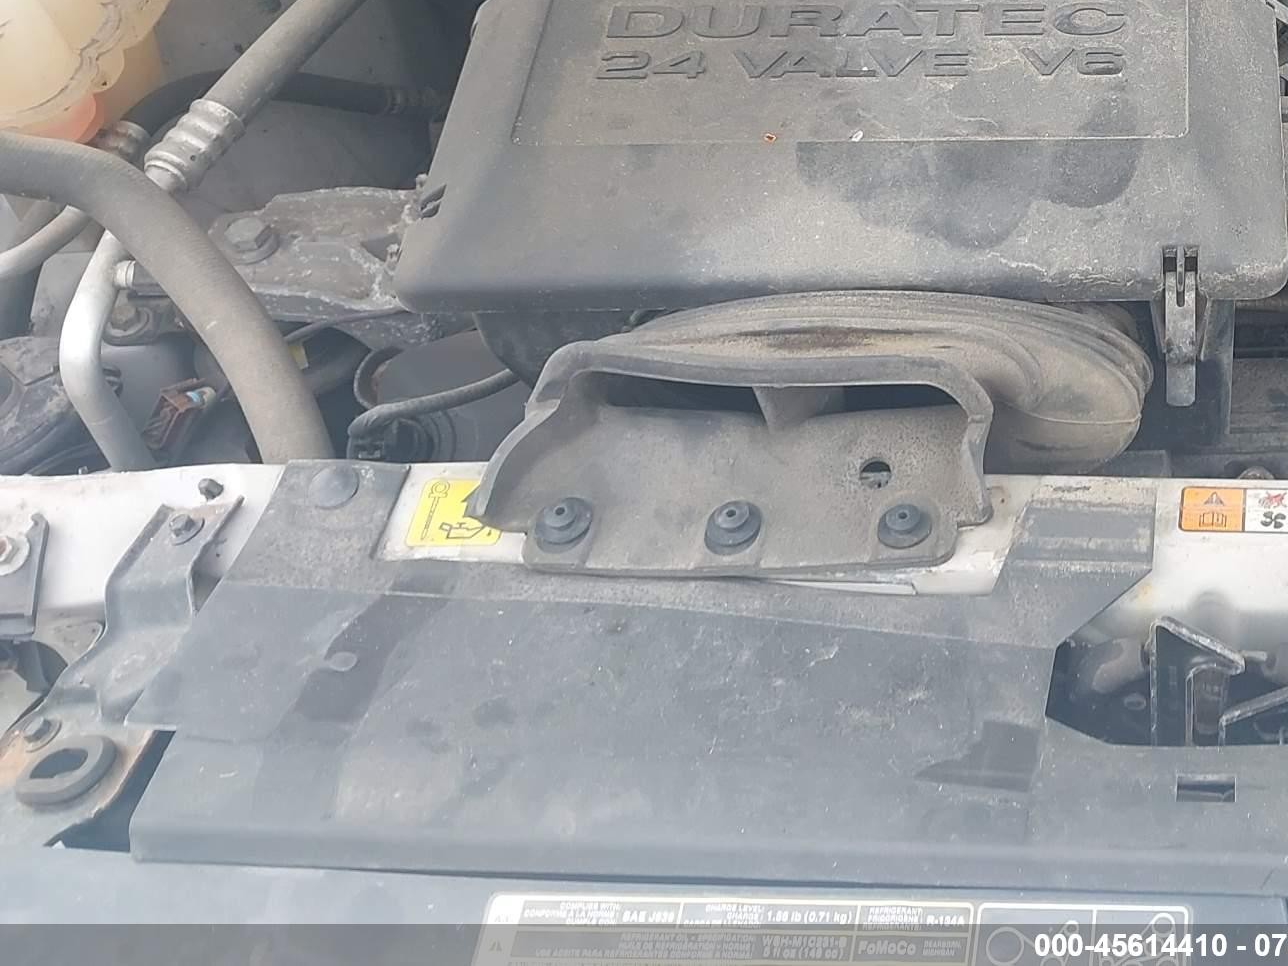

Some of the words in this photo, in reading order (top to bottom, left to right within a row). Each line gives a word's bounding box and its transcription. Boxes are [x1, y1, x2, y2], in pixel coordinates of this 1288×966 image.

[603, 2, 1126, 39] DURATEC
[596, 48, 706, 80] 24
[739, 48, 970, 80] VALVE
[1020, 48, 1126, 78] V6
[622, 911, 646, 923] SAE
[791, 911, 801, 922] lb
[804, 911, 830, 923] (0.71
[832, 912, 852, 924] kg)
[926, 914, 966, 926] R-134A
[858, 940, 917, 955] FoMoCo
